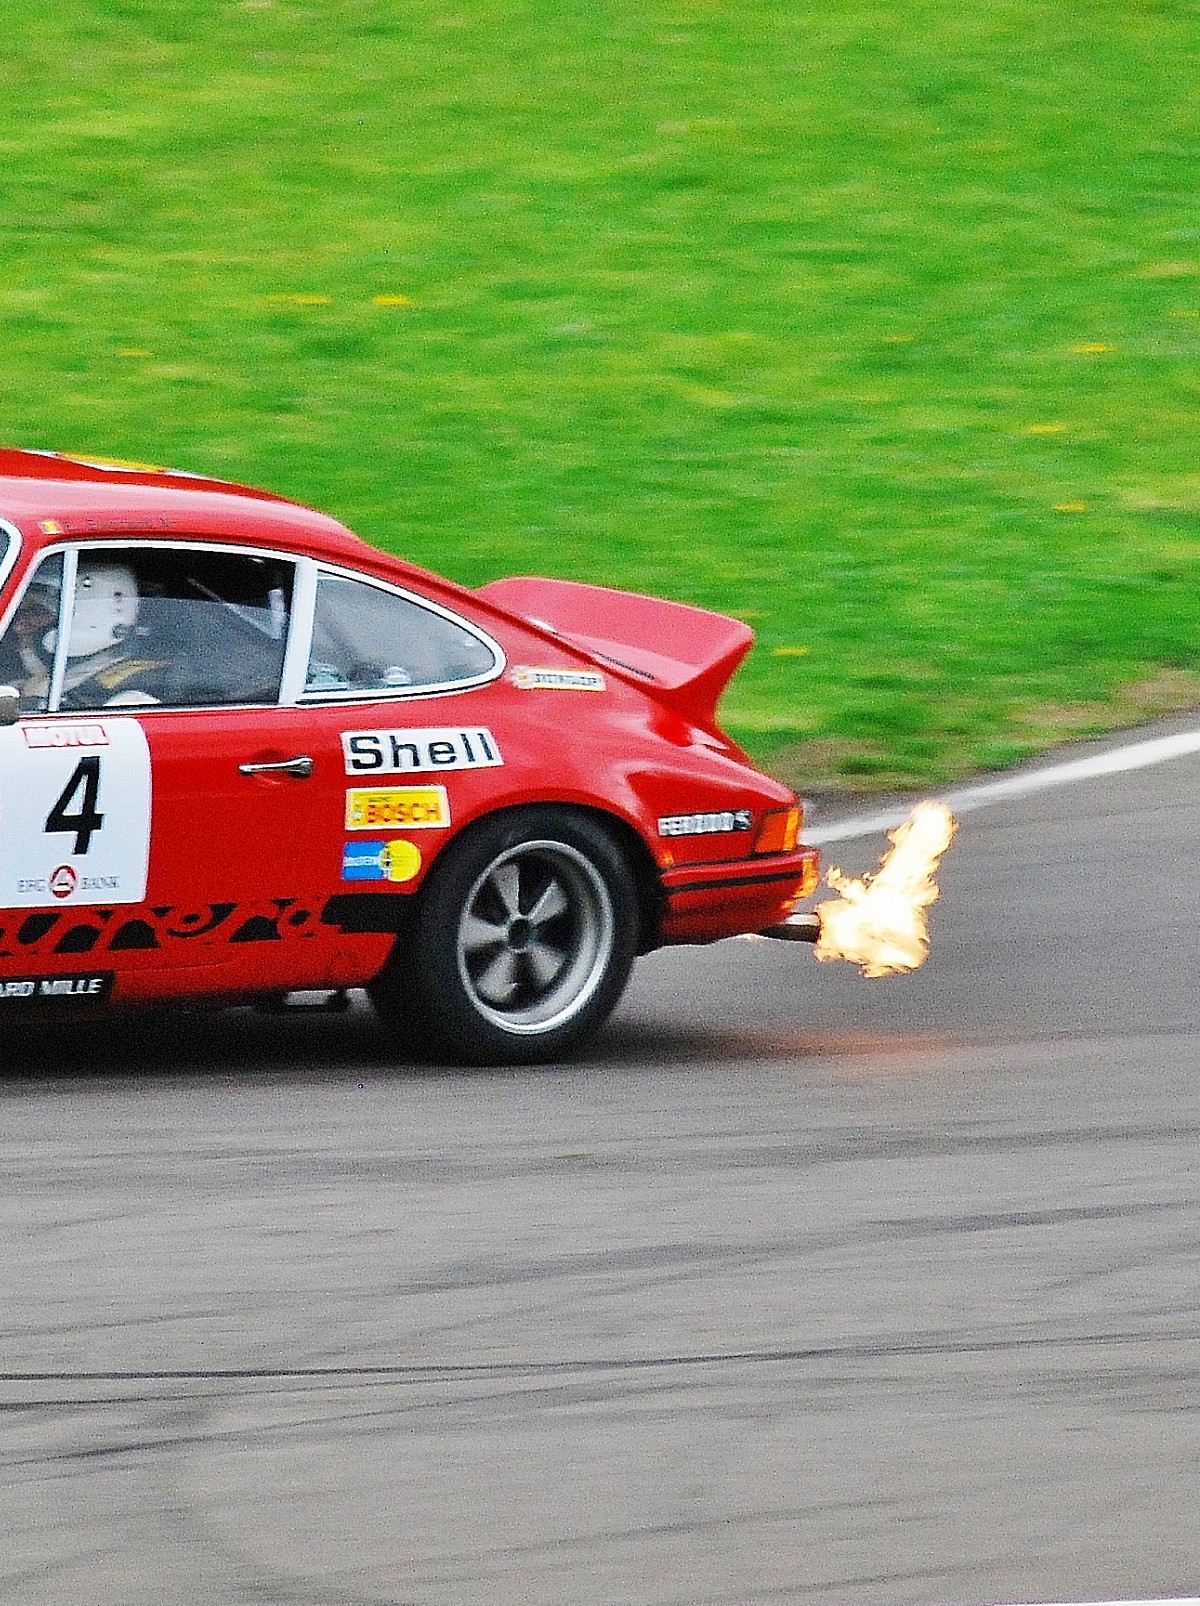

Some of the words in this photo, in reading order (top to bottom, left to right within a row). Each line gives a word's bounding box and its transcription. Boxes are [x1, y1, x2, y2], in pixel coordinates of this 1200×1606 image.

[349, 733, 494, 769] Shell
[43, 756, 105, 856] 4
[367, 803, 441, 823] BOSCH
[38, 979, 103, 996] MILLE
